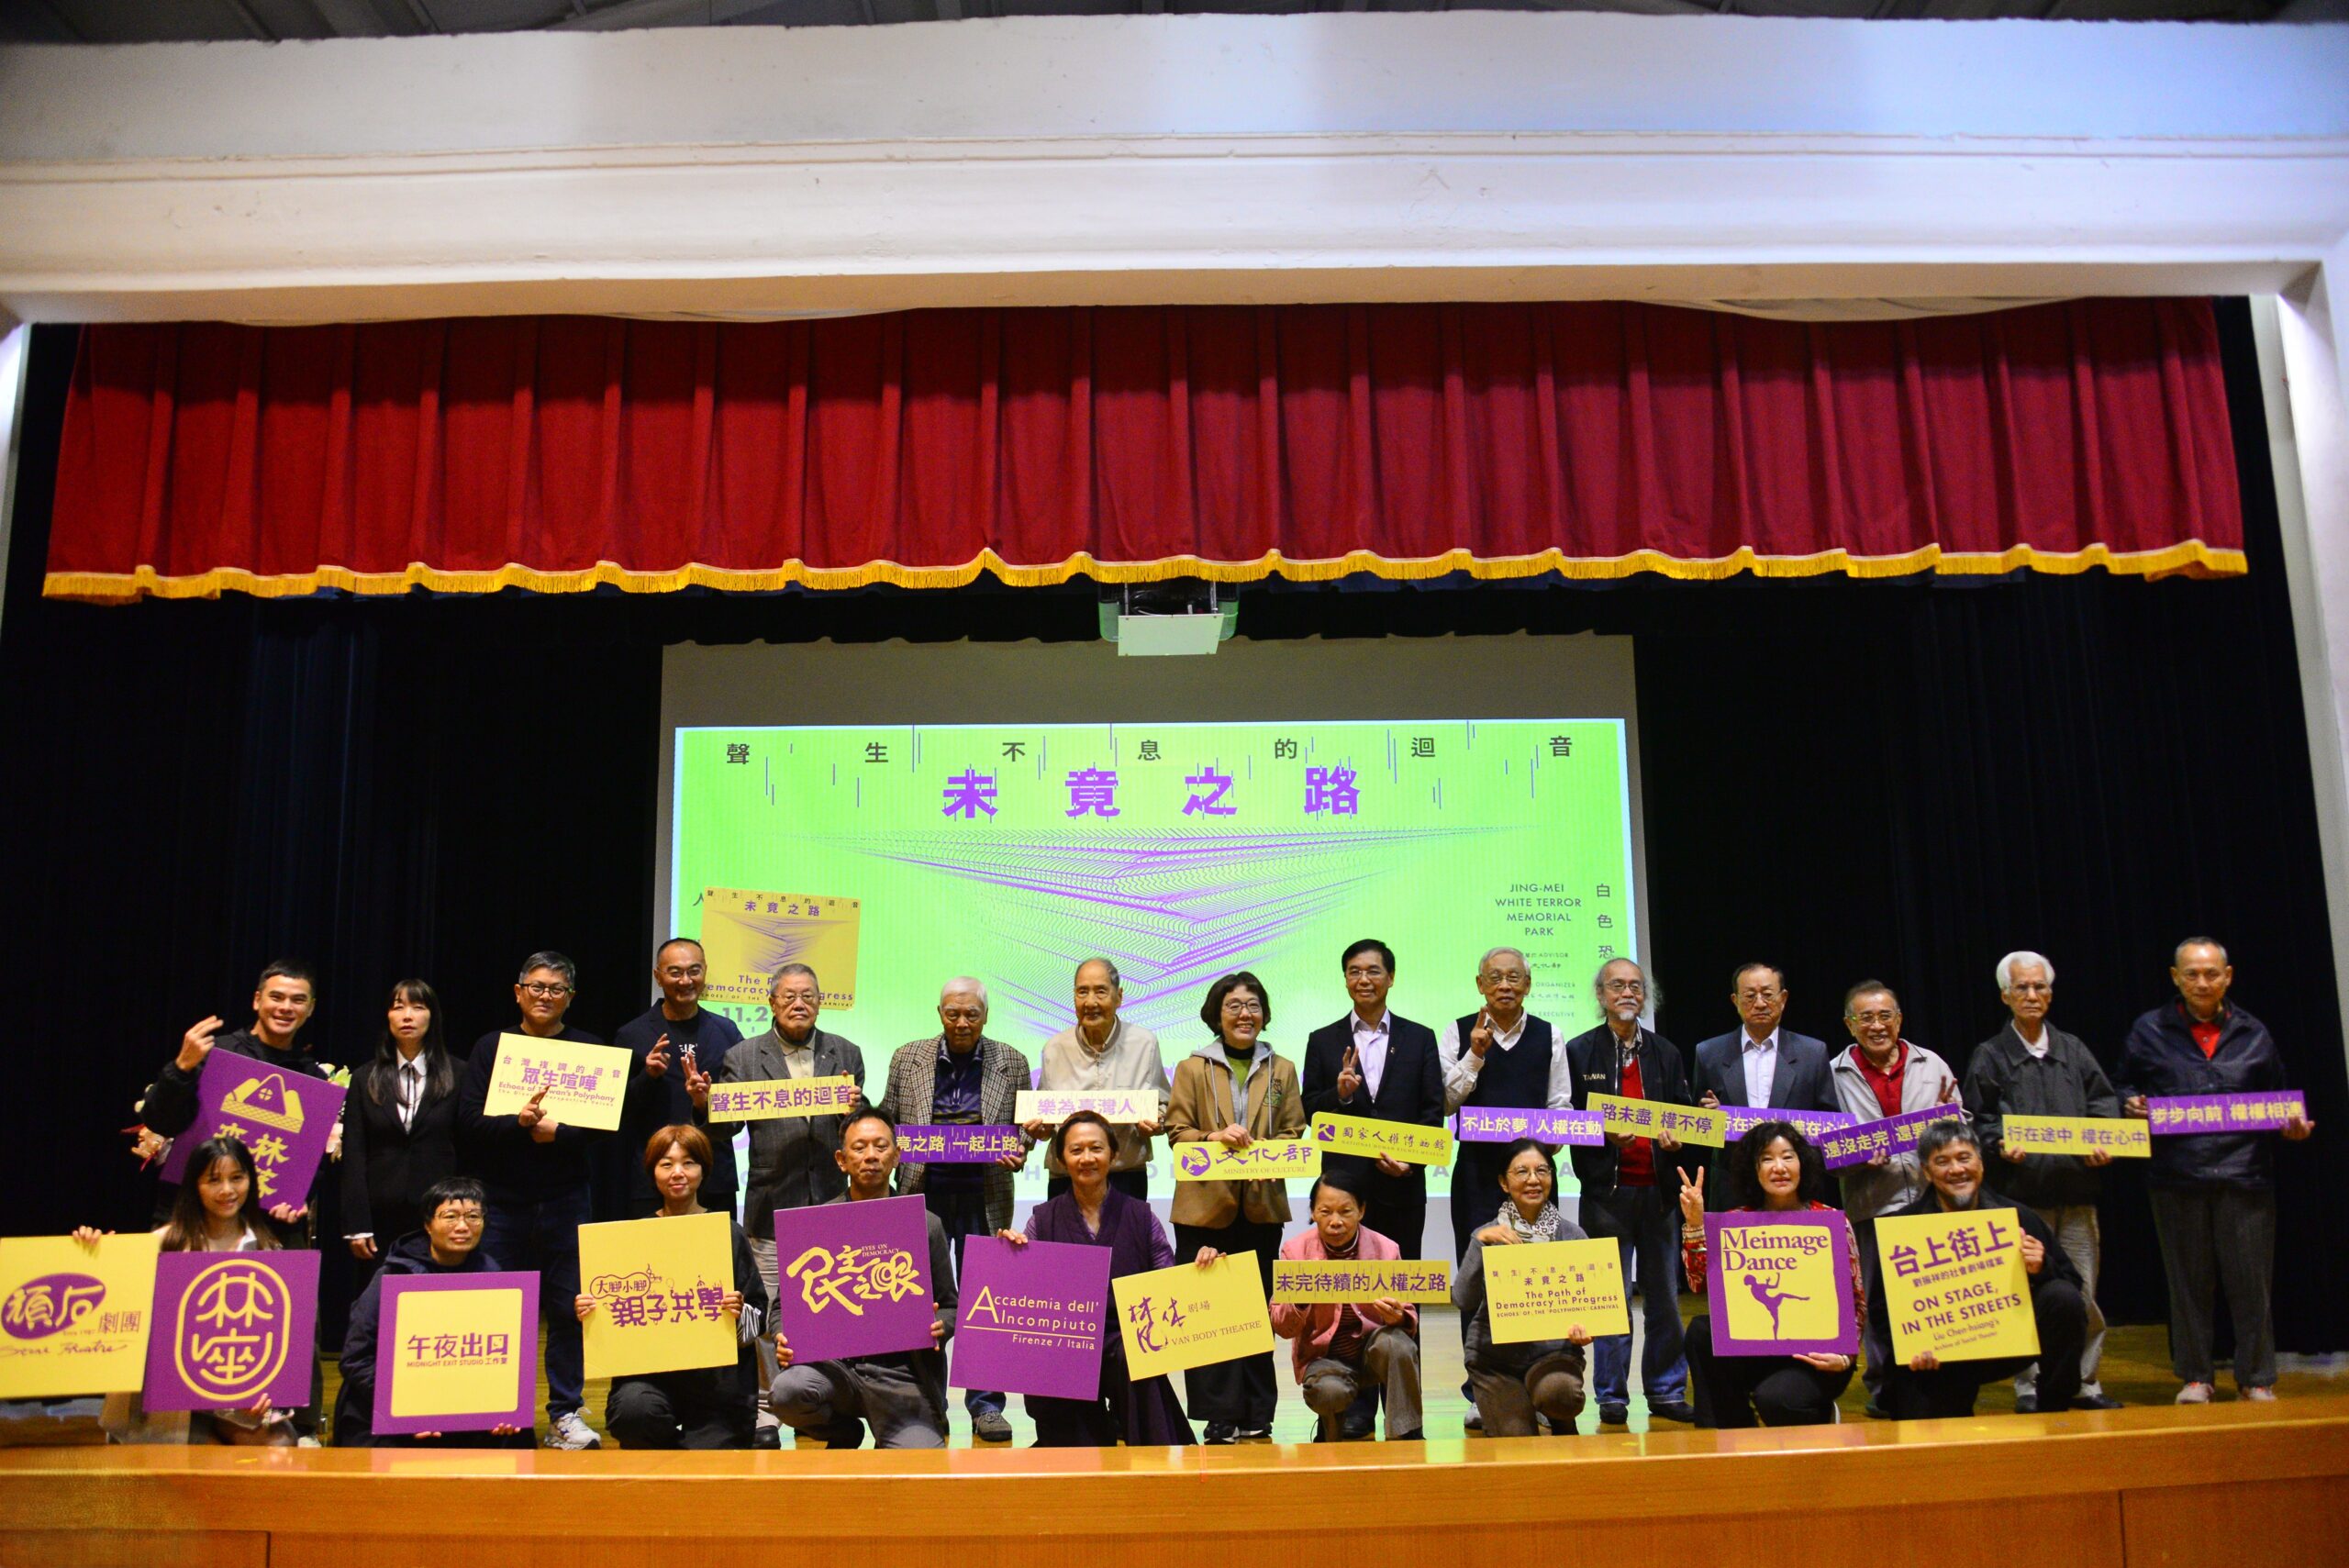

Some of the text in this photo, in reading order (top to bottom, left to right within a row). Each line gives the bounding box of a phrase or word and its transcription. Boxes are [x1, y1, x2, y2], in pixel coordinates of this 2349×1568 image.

[727, 736, 1574, 765] 聲生不息的迴音
[942, 765, 1360, 820] 未竟之路
[1510, 884, 1564, 893] JING-MEI
[744, 901, 820, 917] 未竟之路
[1496, 898, 1582, 907] WHITE TERROR
[1507, 913, 1572, 922] MEMORIAL
[1525, 928, 1554, 937] PARK
[739, 975, 761, 985] The
[707, 984, 771, 997] emocracy
[499, 1081, 525, 1092] Echoes
[539, 1086, 571, 1096] Twan's
[573, 1090, 616, 1103] Polyphony
[710, 1084, 852, 1113] 聲生不息的迴音
[1536, 1118, 1602, 1136] 人權在動
[1660, 1110, 1713, 1134] 權不停
[2007, 1125, 2073, 1143] 行在途中
[952, 1135, 1019, 1152] 一起上路
[1824, 1130, 1890, 1159] 還沒走完
[1216, 1144, 1313, 1166] 文化部
[1224, 1167, 1258, 1175] MINISTRY
[1272, 1166, 1307, 1174] CULTURE
[1721, 1229, 1829, 1255] Meimage
[1889, 1220, 2013, 1278] 台上街上
[862, 1248, 900, 1258] DEMOCRACY
[1724, 1251, 1798, 1271] Dance
[1276, 1273, 1447, 1293] 未完待續的人權之路
[1525, 1273, 1585, 1286] 未竟之路
[1496, 1295, 1619, 1310] Democracy in Progress
[1526, 1291, 1543, 1299] The
[1548, 1289, 1571, 1298] Path
[610, 1286, 724, 1328] 親子共學
[966, 1284, 1099, 1325] Accademia dell'
[1549, 1306, 1586, 1314] POLYPHONIC
[1913, 1296, 1940, 1312] ON
[1001, 1309, 1097, 1332] Incompiuto
[1902, 1293, 2021, 1336] IN THE STREETS
[1012, 1333, 1052, 1347] Firenze
[1067, 1339, 1095, 1351] Italia
[1172, 1320, 1262, 1346] VAN BODY THEATRE
[407, 1332, 509, 1360] 午夜出口
[406, 1360, 441, 1368] MIDNIGHT
